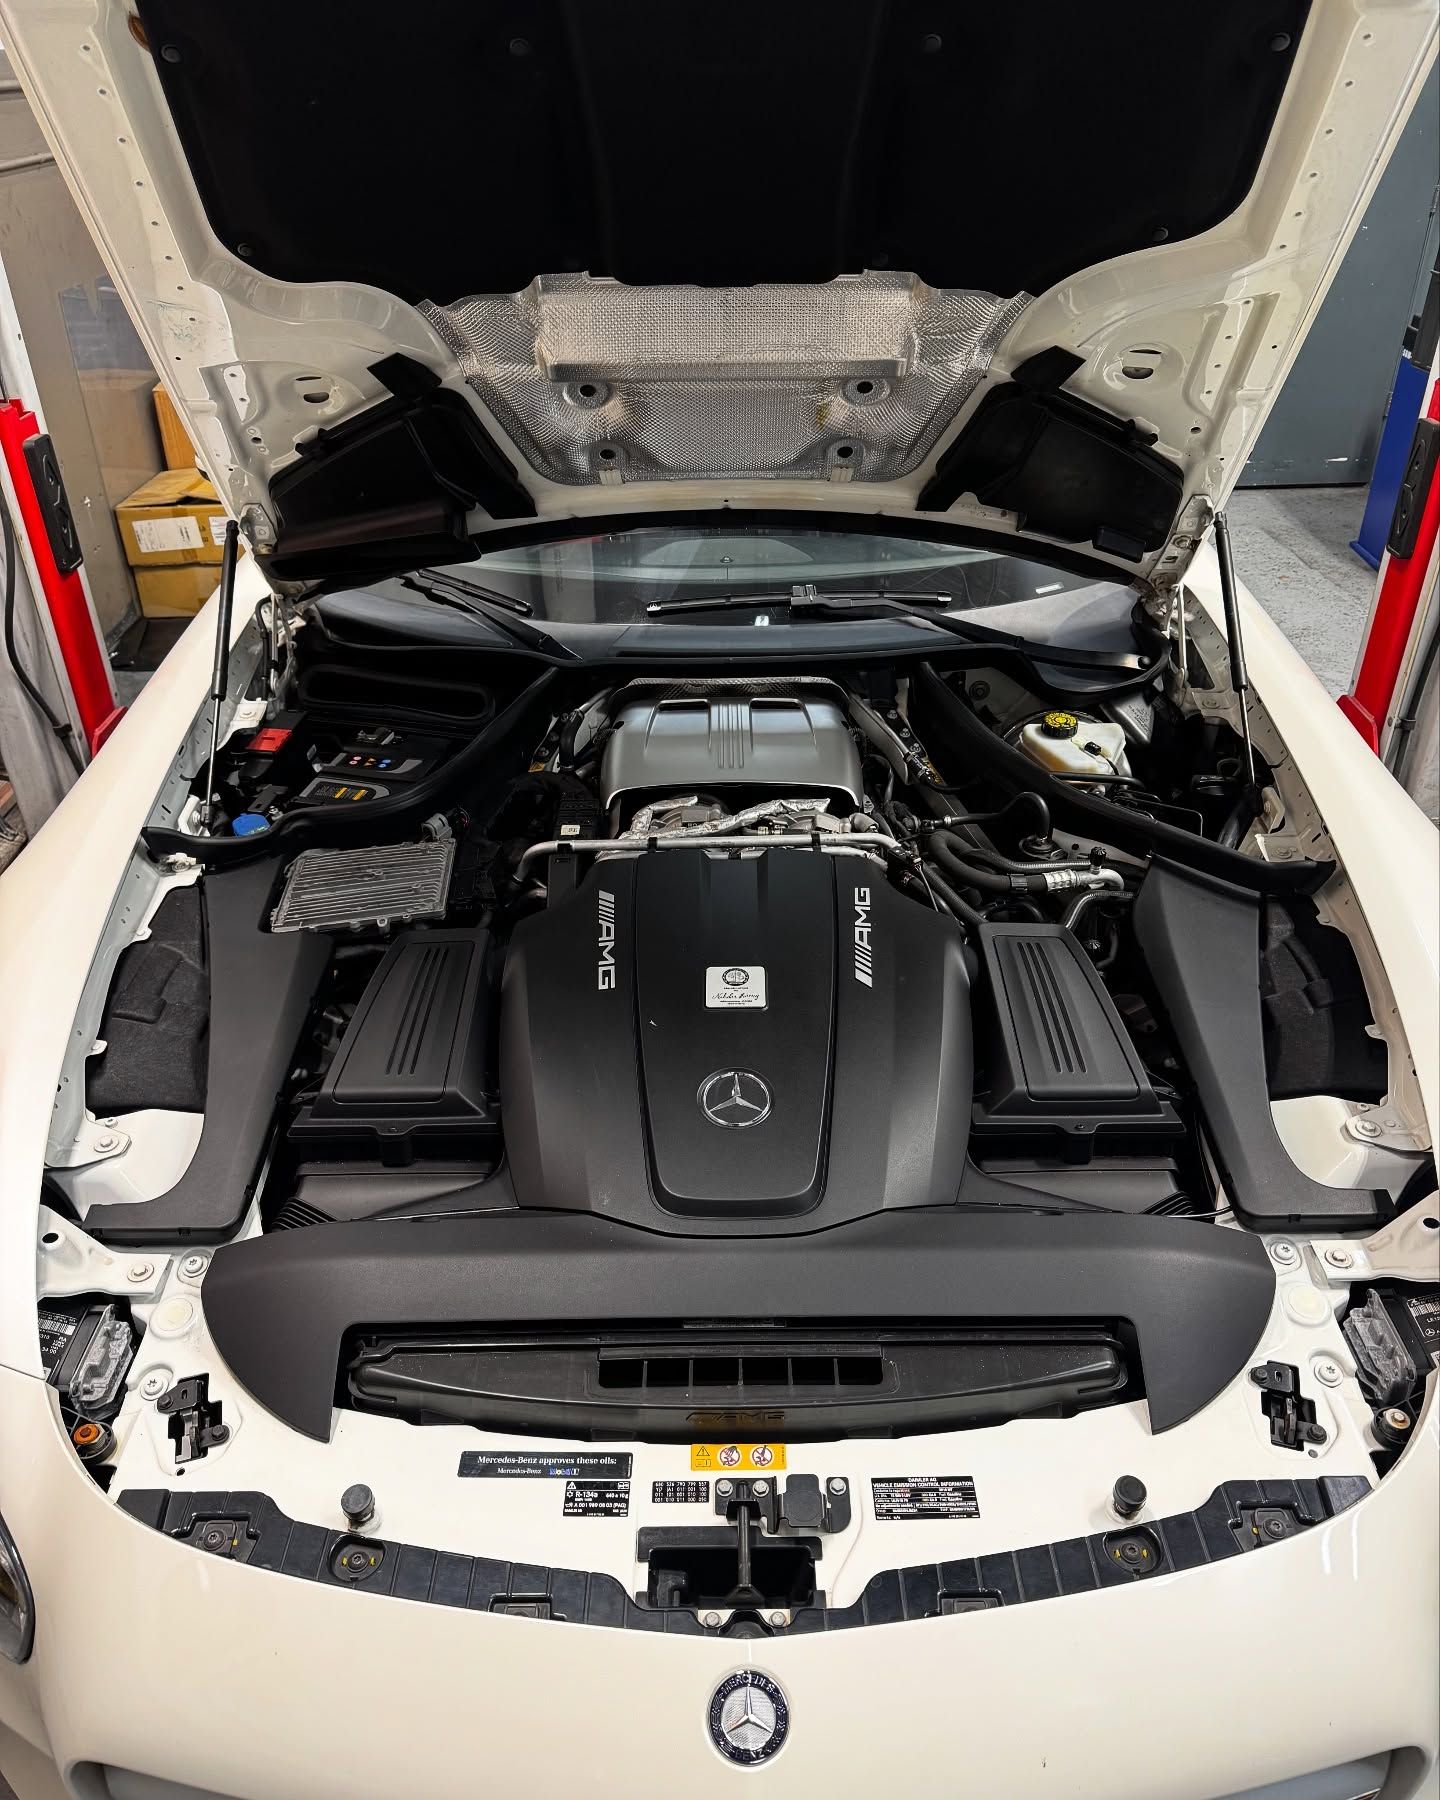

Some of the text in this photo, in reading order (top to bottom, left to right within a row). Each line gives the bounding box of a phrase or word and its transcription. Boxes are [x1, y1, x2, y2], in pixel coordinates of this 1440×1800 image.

[854, 887, 872, 951] AMG
[598, 919, 616, 990] AMG
[477, 1456, 617, 1467] Mercedes-Benz approves these oils:
[722, 1673, 776, 1695] MERCEDES
